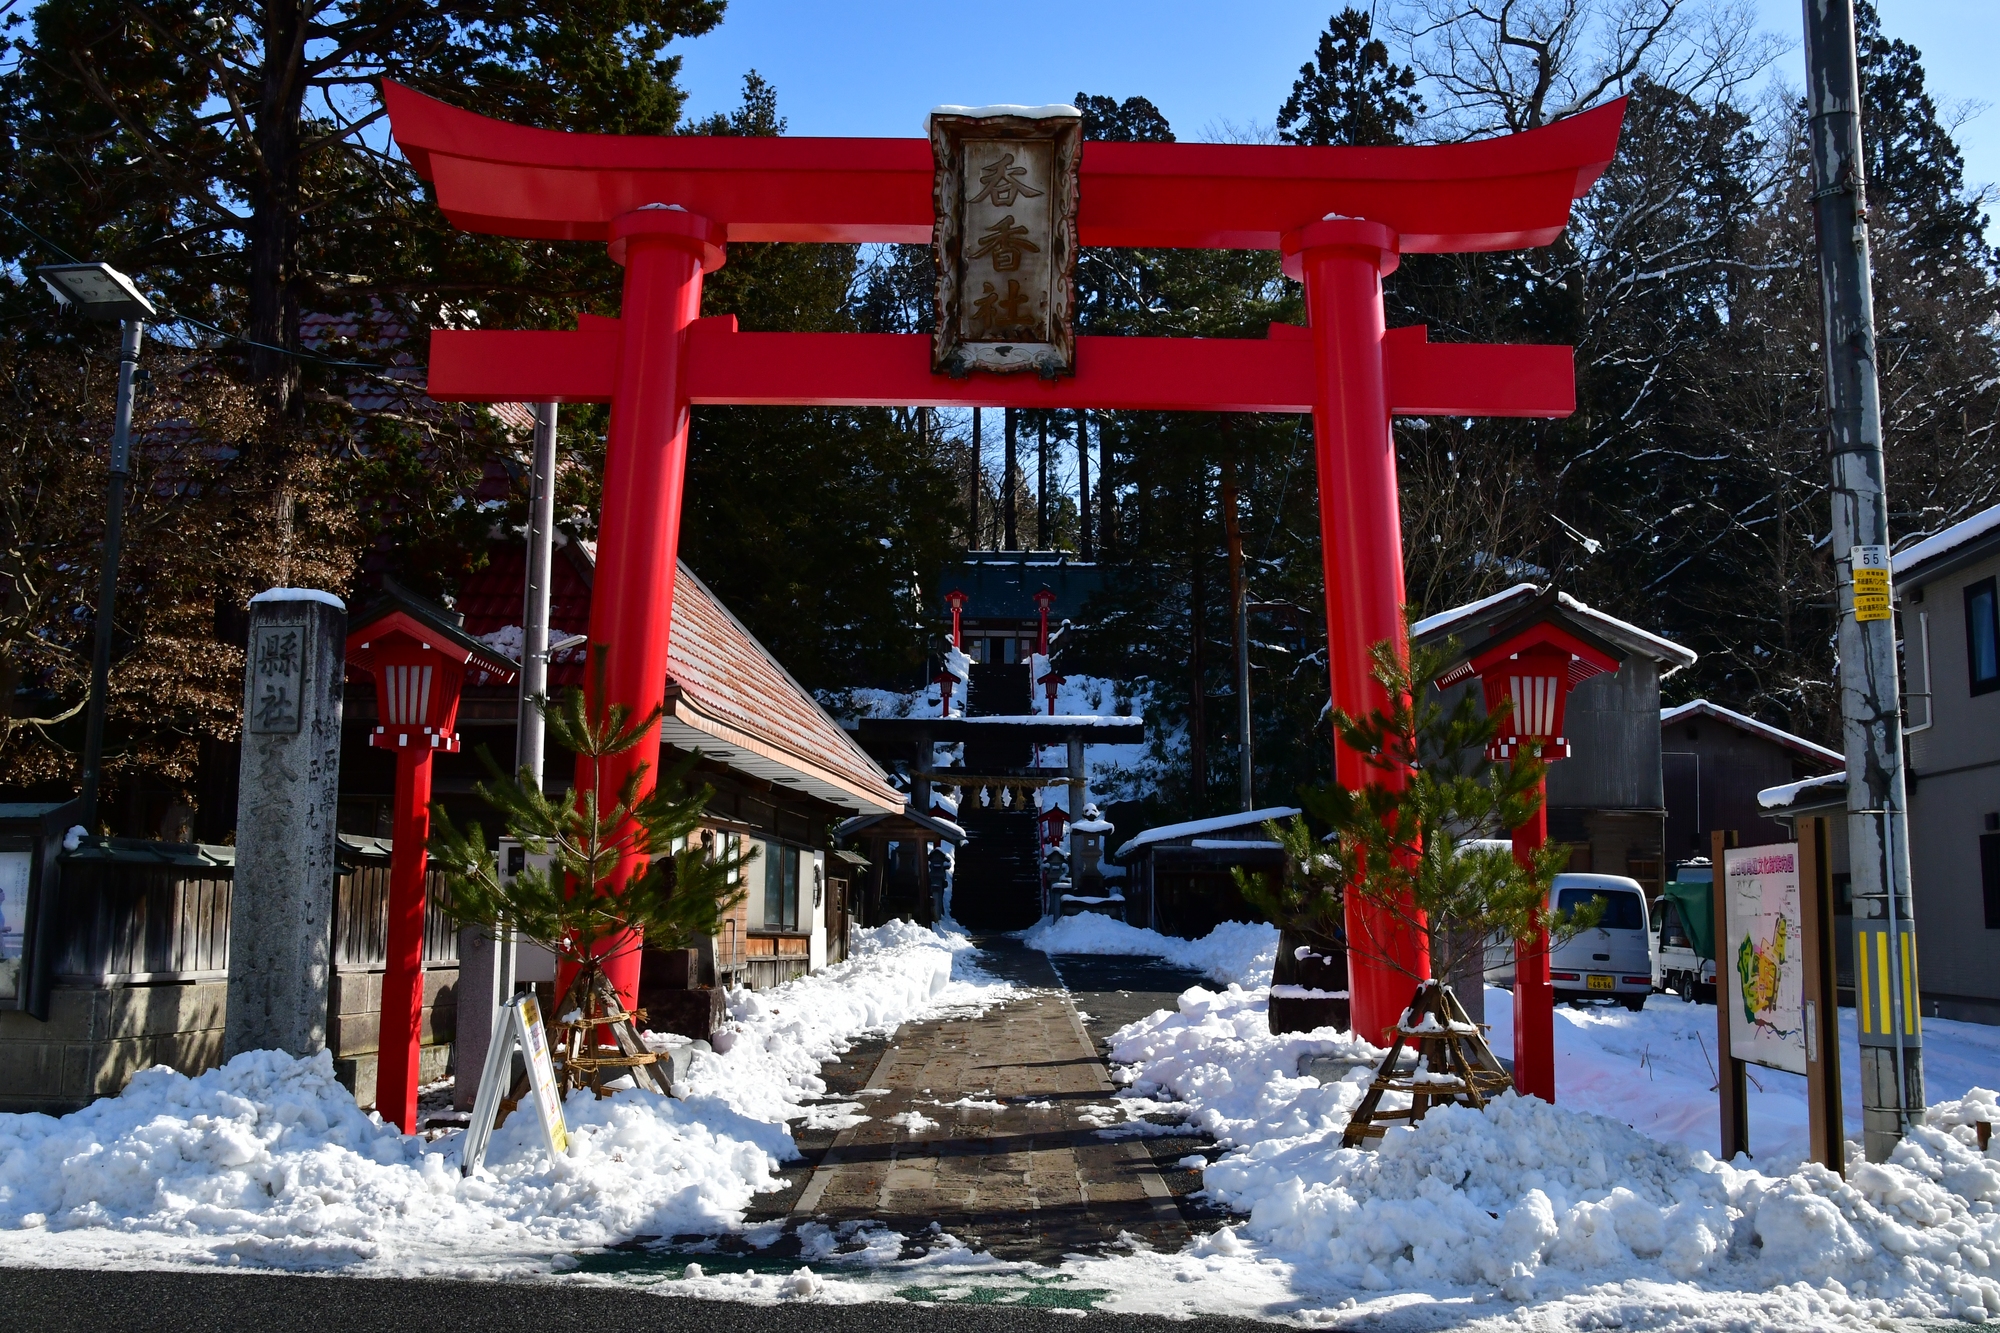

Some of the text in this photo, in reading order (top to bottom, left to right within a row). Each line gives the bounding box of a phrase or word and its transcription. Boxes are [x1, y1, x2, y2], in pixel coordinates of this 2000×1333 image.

[968, 153, 1044, 330] 呑香社
[1863, 553, 1879, 565] 55
[254, 630, 299, 730] 縣社
